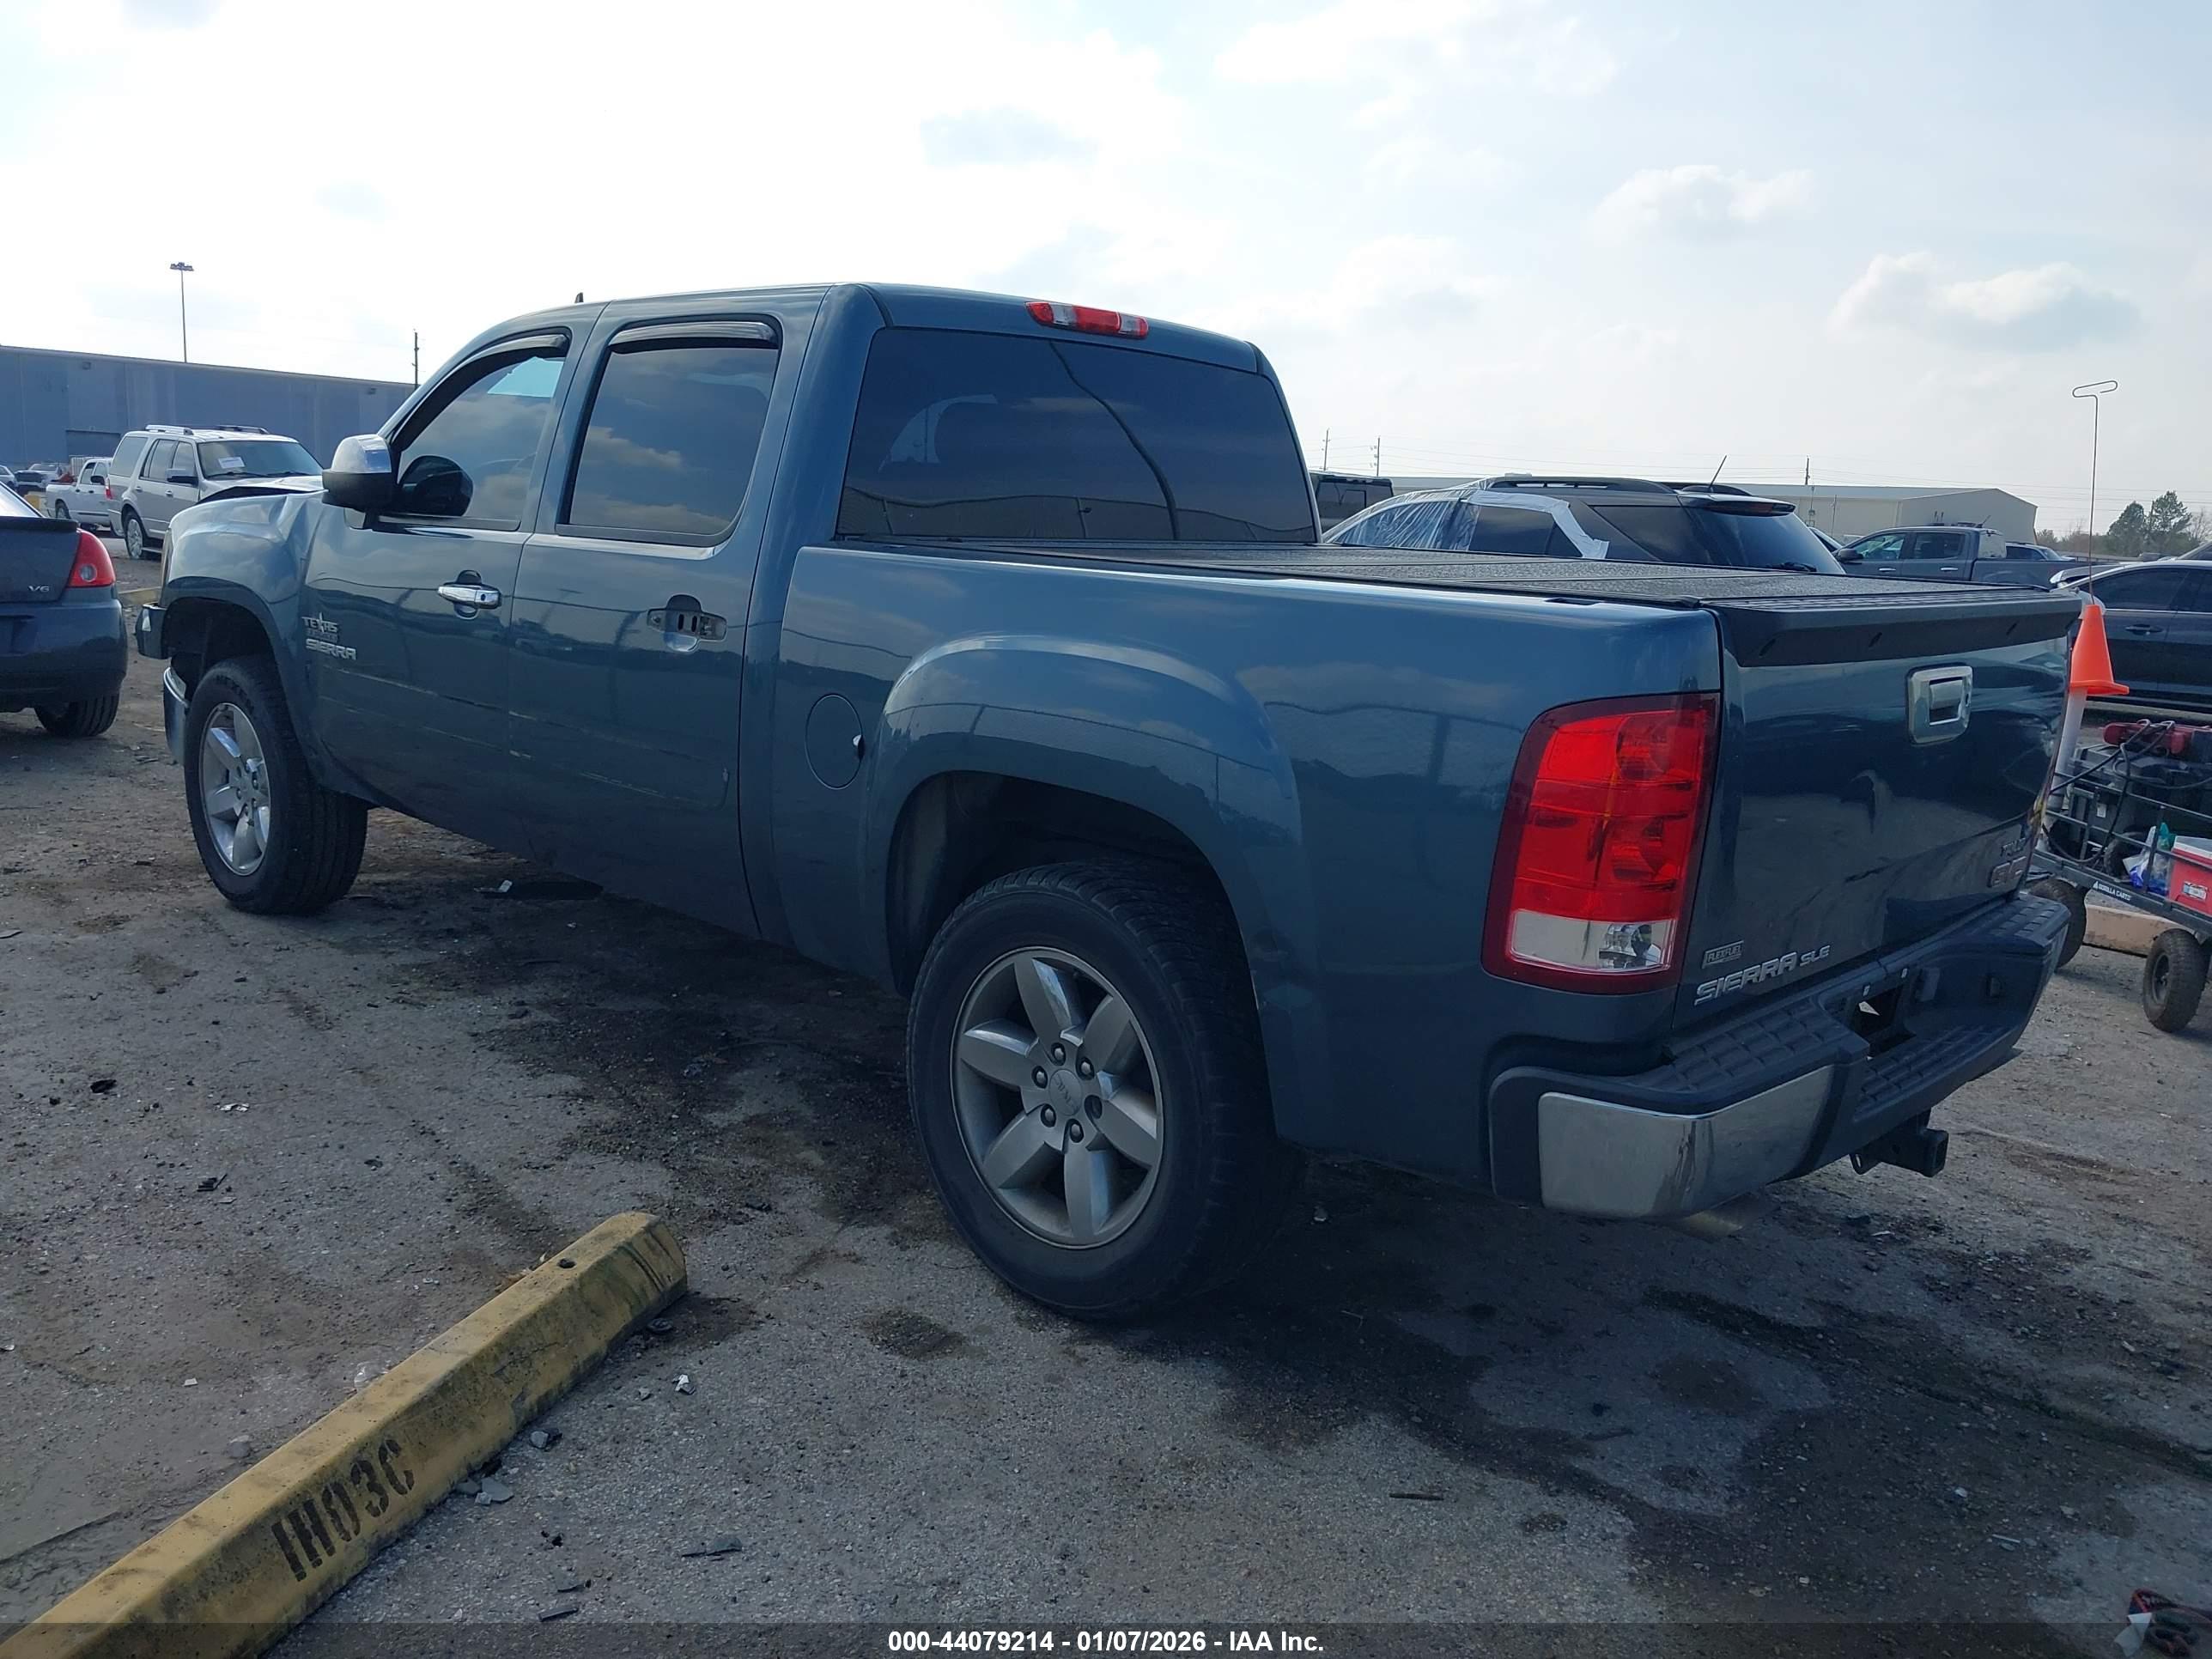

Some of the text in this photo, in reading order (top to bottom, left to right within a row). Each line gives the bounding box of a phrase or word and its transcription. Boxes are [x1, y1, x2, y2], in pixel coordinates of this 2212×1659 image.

[301, 613, 338, 633] TEXAS
[306, 638, 356, 660] SIERRA
[1694, 945, 1831, 1006] SIERRA SLE
